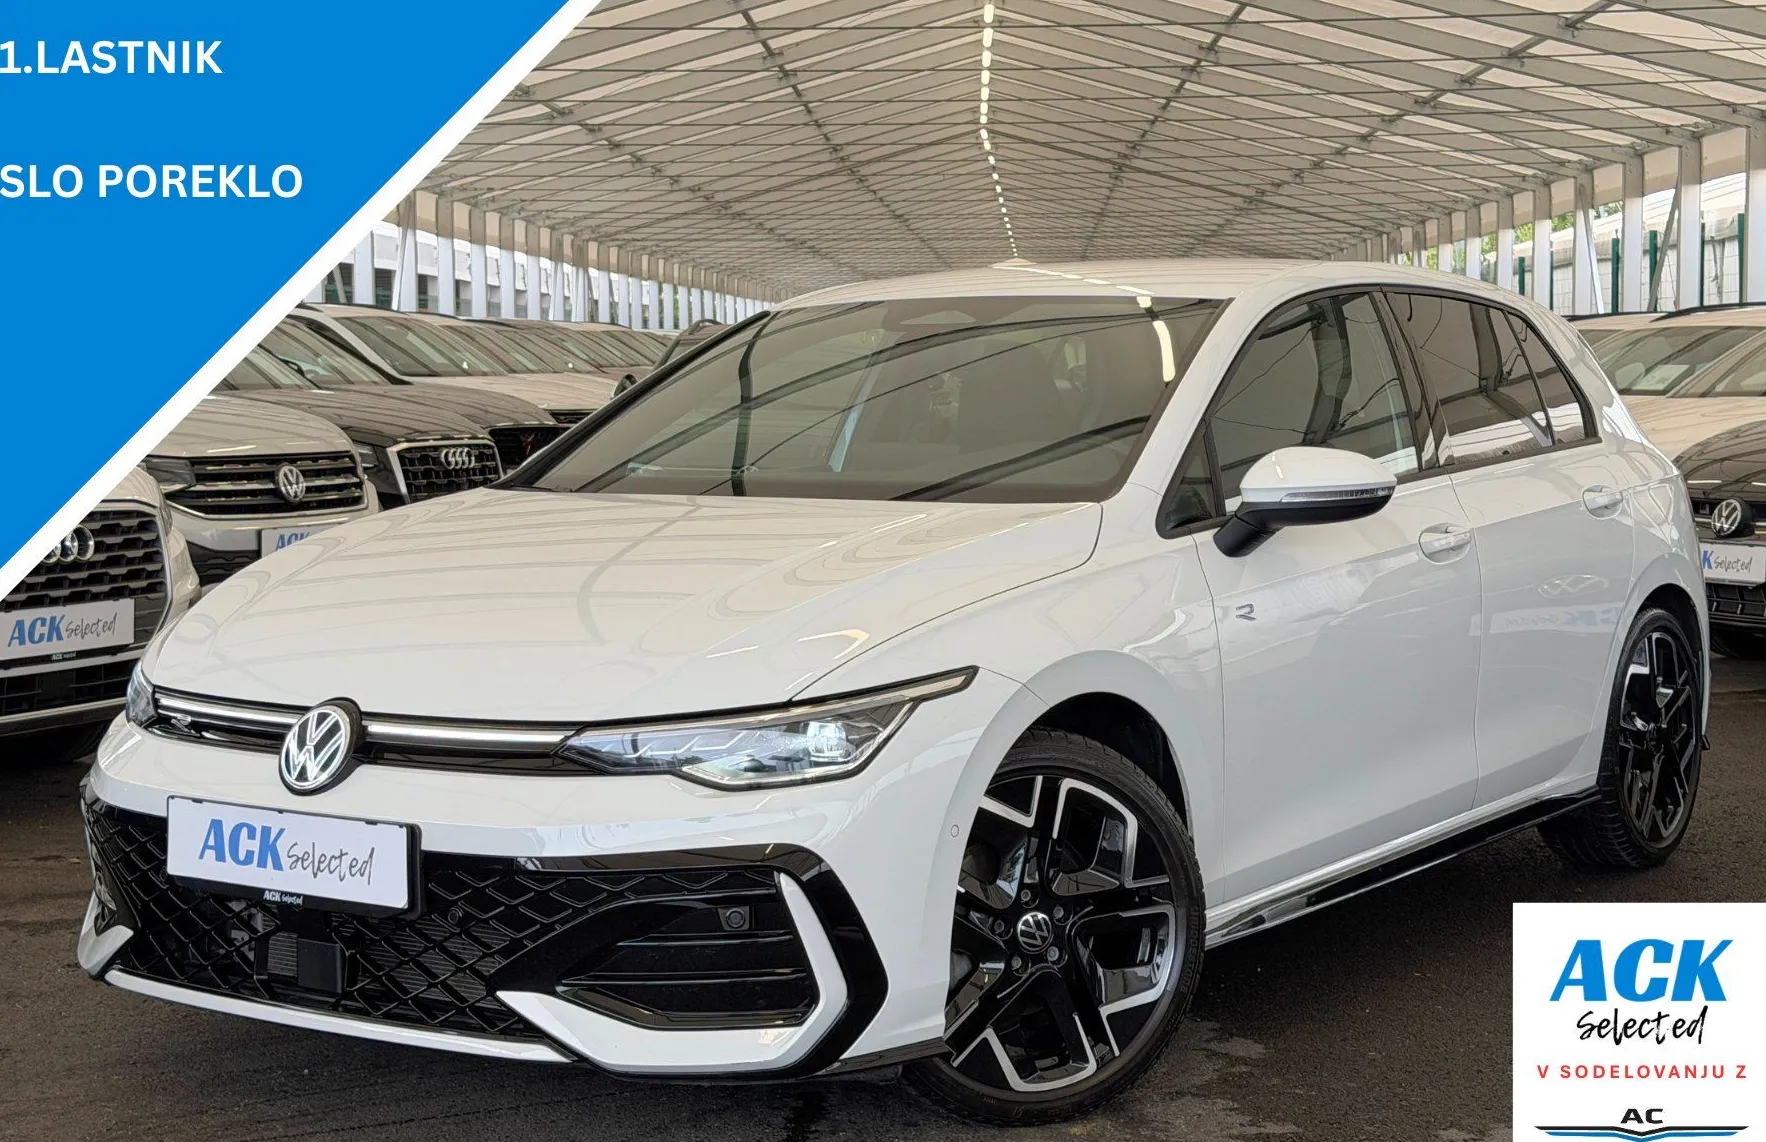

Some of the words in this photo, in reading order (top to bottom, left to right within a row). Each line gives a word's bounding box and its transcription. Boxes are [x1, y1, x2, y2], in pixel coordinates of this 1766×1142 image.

[1713, 555, 1753, 574] Selected
[7, 614, 66, 648] ACK
[65, 612, 118, 640] Selected
[199, 818, 286, 873] ACK
[286, 842, 376, 886] Selected
[263, 889, 281, 902] ACK
